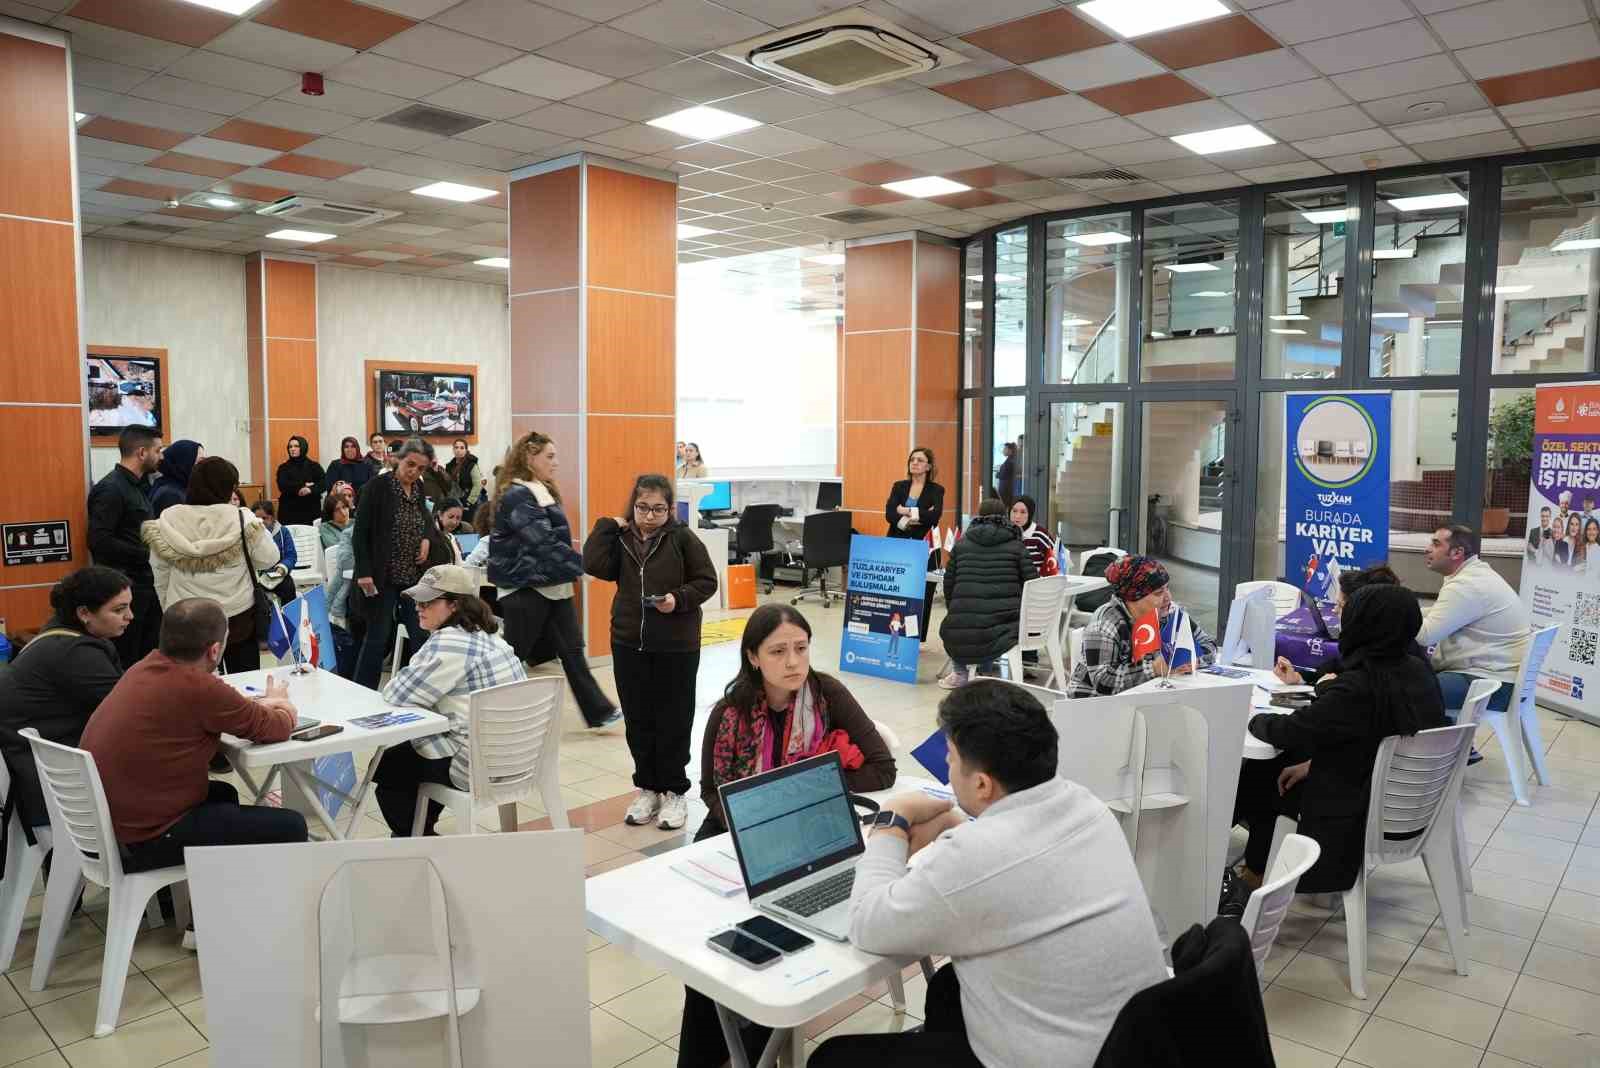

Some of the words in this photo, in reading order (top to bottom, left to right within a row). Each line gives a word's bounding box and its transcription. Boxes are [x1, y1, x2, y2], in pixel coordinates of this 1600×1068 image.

[1542, 438, 1569, 452] ÖZEL
[1305, 509, 1362, 526] BURADA
[1295, 522, 1374, 544] KARİYER
[1311, 538, 1355, 559] VAR
[852, 562, 874, 571] TUZLA
